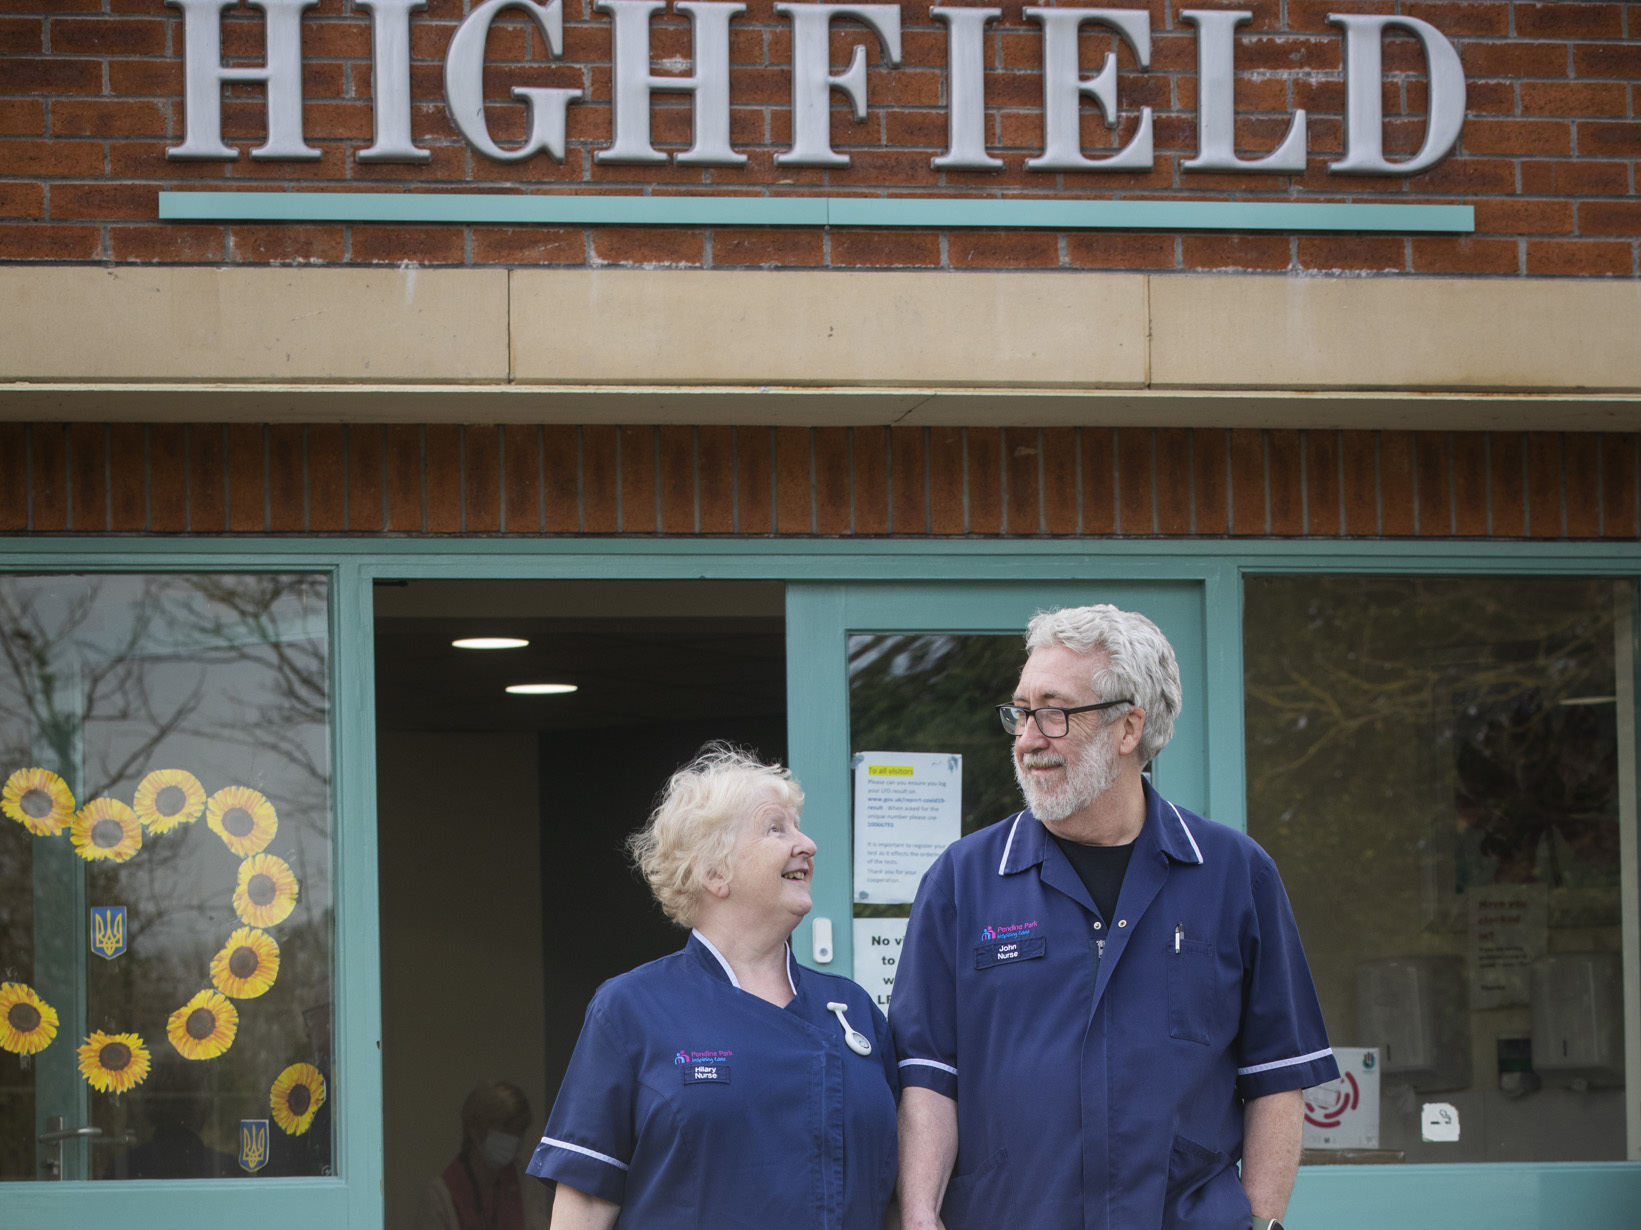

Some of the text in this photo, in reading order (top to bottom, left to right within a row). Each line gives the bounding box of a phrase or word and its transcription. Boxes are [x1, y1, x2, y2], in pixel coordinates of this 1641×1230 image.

[165, 0, 1467, 176] HIGHFIELD
[998, 920, 1037, 932] Pendine Park
[872, 936, 905, 945] No v
[999, 944, 1016, 952] John
[882, 956, 895, 965] to
